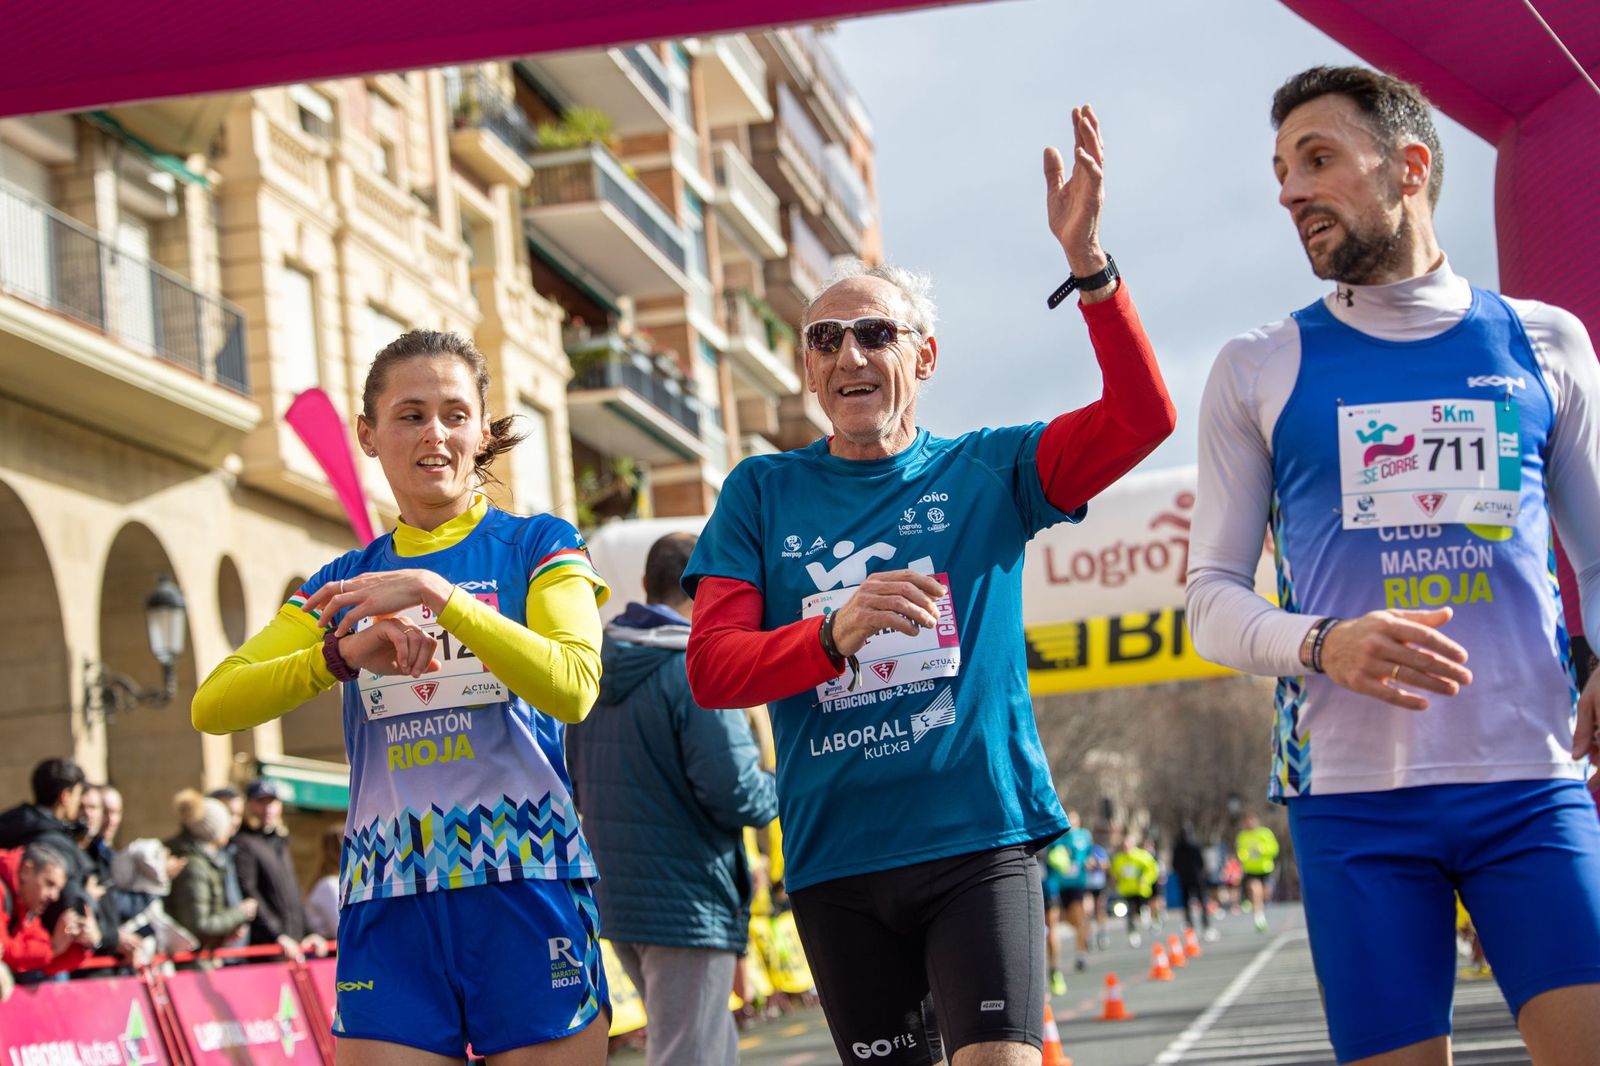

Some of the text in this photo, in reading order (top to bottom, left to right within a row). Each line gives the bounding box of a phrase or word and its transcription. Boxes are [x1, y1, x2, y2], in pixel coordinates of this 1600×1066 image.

[1432, 405, 1474, 423] 5Km
[1423, 437, 1485, 472] 711
[1499, 432, 1519, 457] FIZ
[1361, 454, 1419, 484] SE CORRE
[1378, 524, 1443, 542] CLUB
[1380, 540, 1494, 575] MARATÓN
[1384, 572, 1494, 609] RIOJA
[462, 682, 502, 695] ACTUAL
[822, 679, 935, 713] IV EDICION 08-2-2026
[386, 709, 472, 743] MARATÓN
[810, 719, 908, 757] LABORAL
[387, 734, 475, 772] RIOJA
[864, 740, 910, 760] kutxa
[551, 961, 567, 970] CLUB
[552, 975, 581, 989] RIOJA
